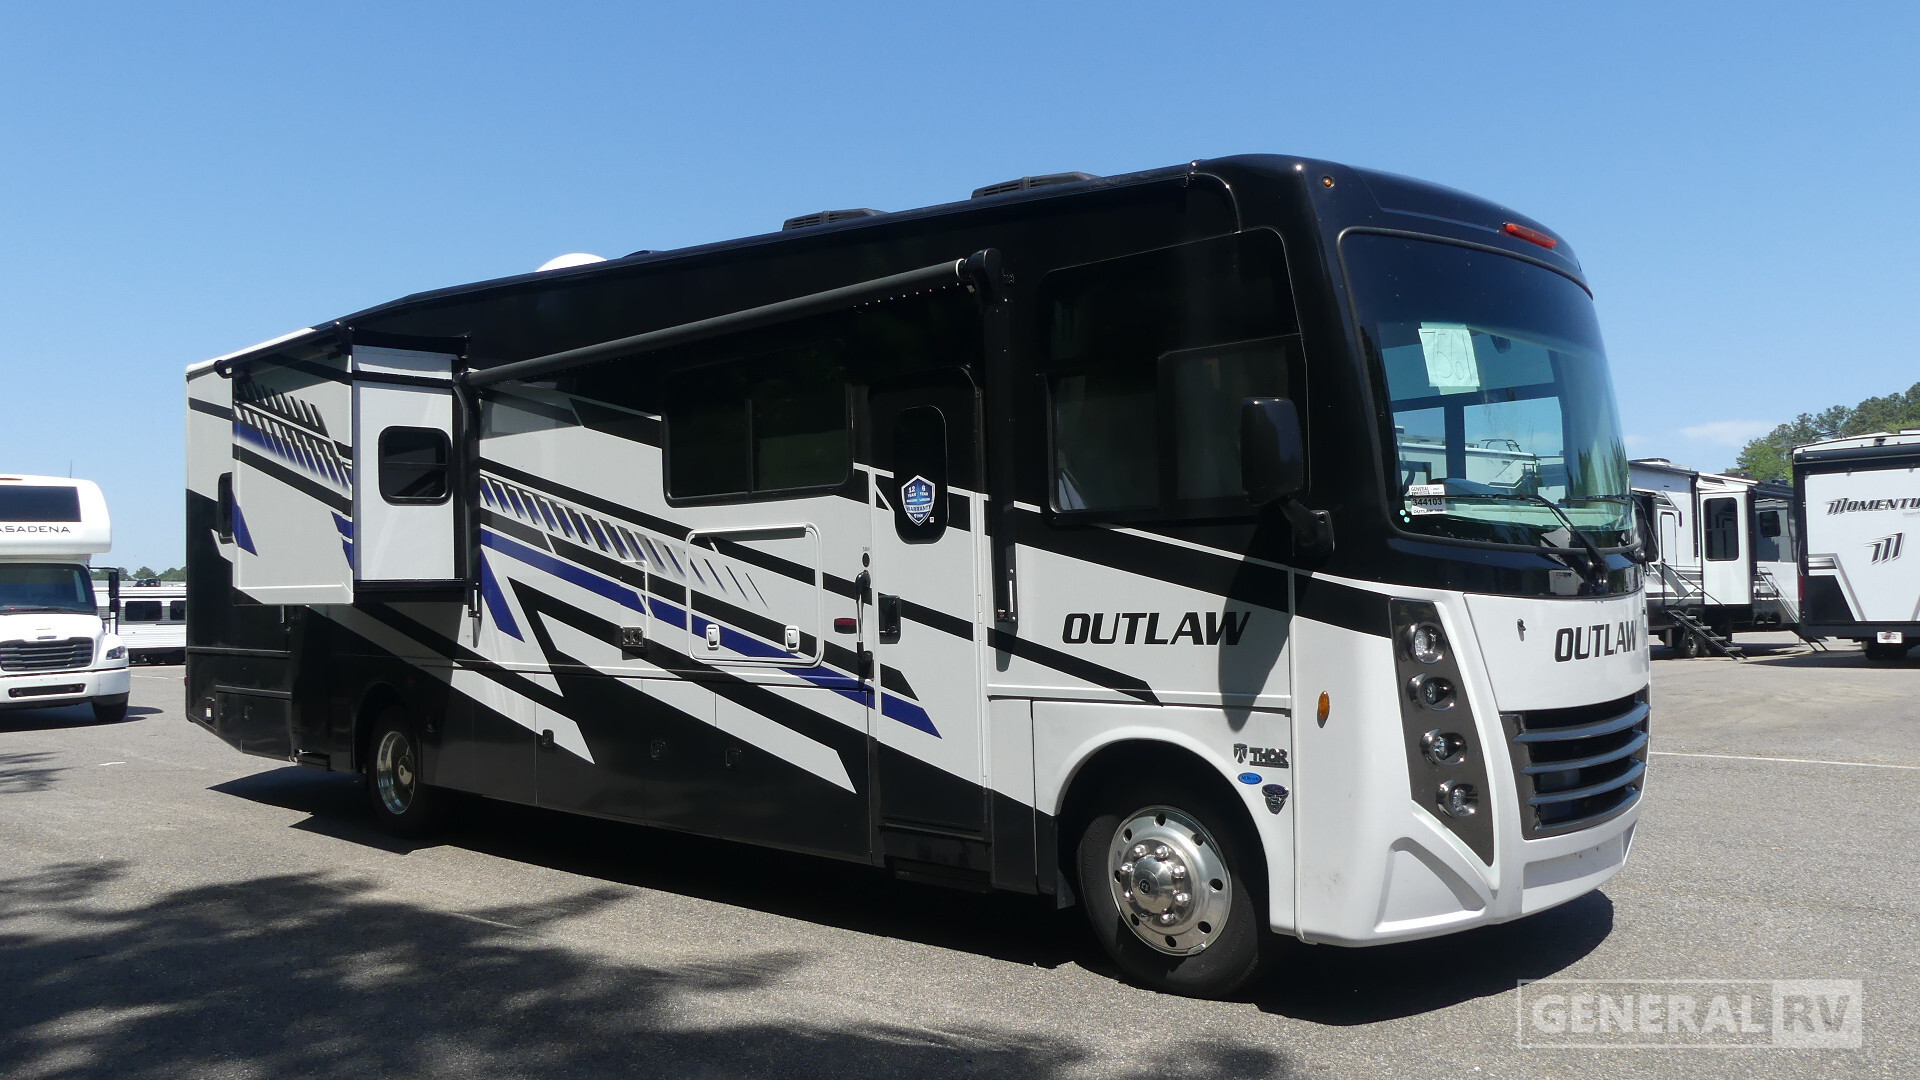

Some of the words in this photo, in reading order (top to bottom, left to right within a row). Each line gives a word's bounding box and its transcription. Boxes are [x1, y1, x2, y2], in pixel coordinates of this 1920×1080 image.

[1412, 498, 1442, 506] 344103
[1062, 611, 1251, 646] OUTLAW
[1554, 619, 1637, 662] OUTLAW
[1249, 747, 1289, 763] THOR
